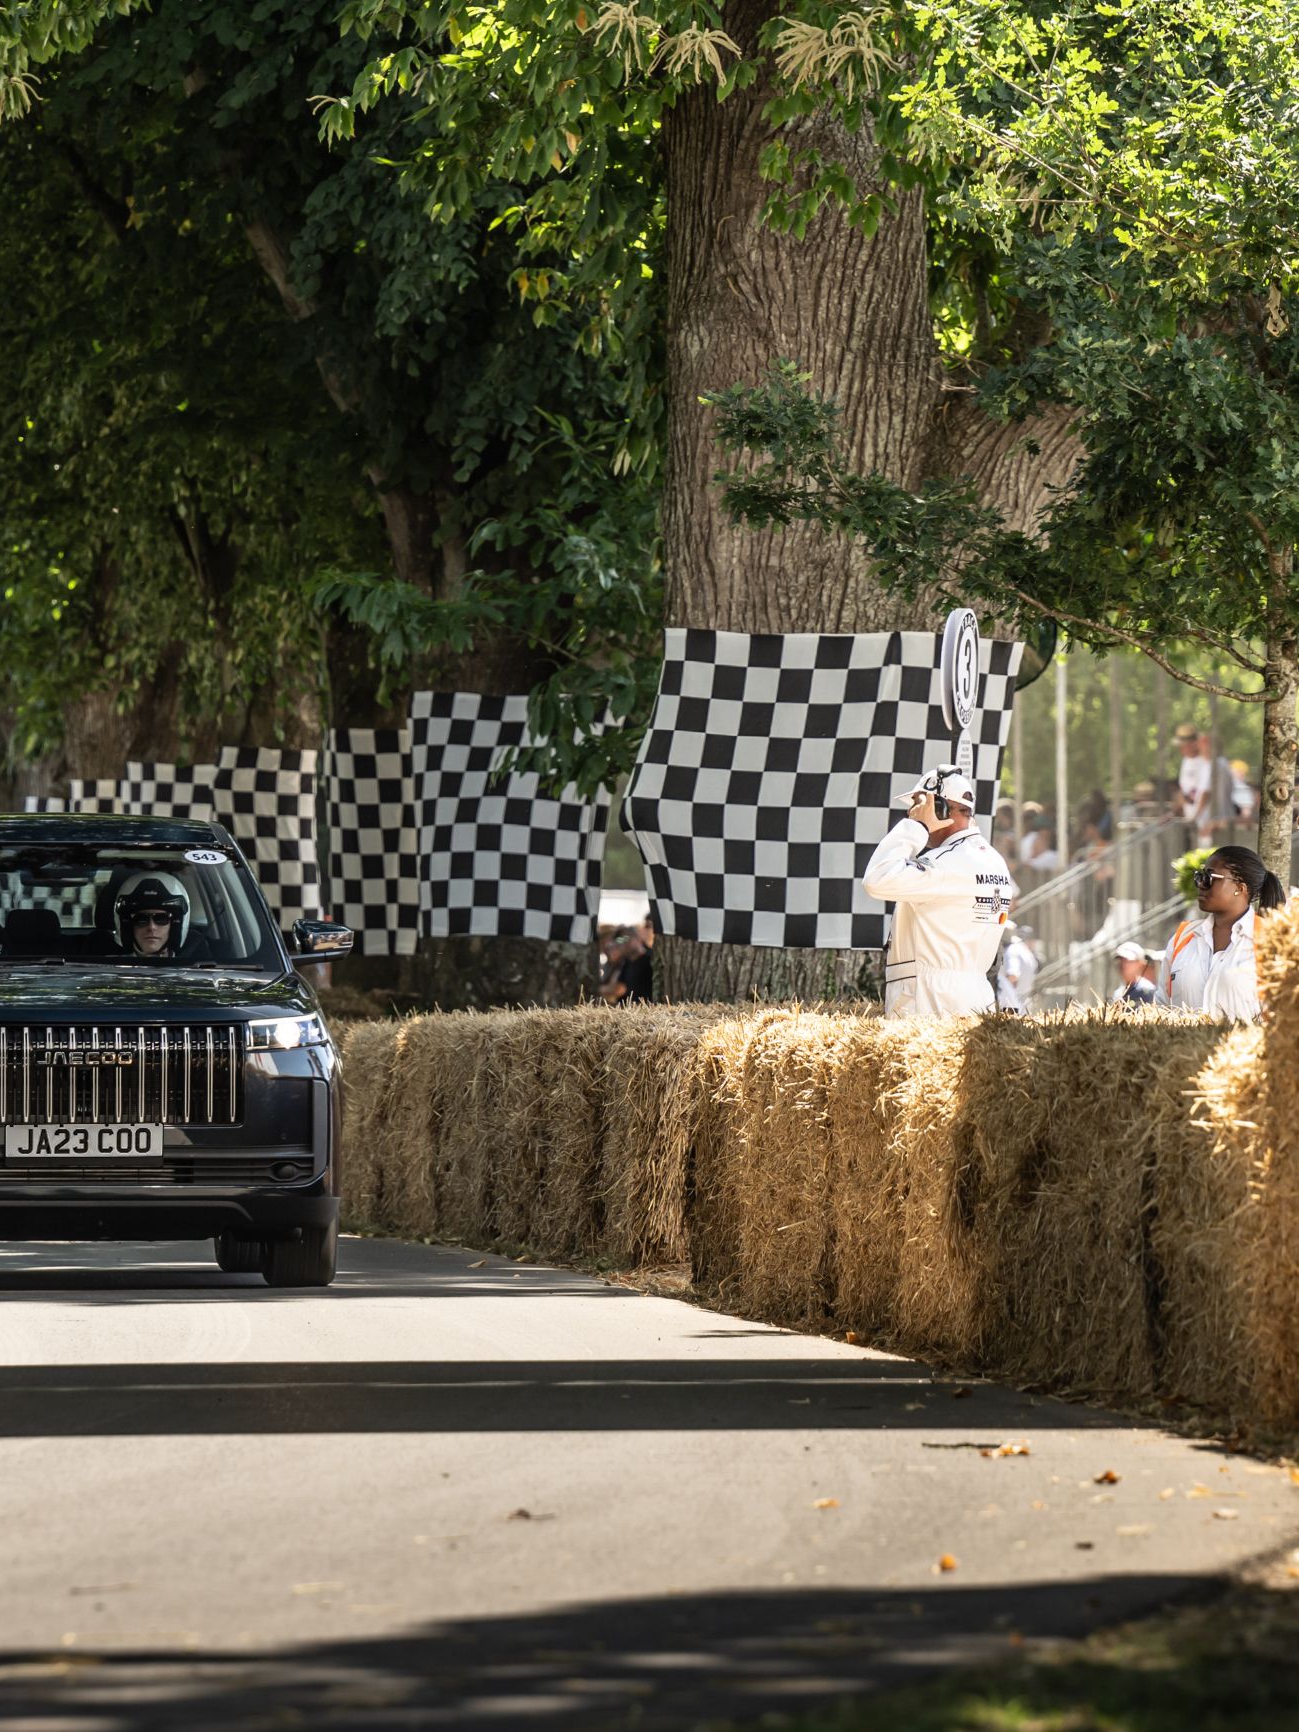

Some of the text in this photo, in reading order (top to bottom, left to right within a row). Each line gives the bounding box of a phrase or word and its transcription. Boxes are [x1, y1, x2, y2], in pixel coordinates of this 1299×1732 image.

[964, 638, 972, 699] 3
[191, 853, 217, 861] 543
[975, 874, 1010, 886] MARSHA
[36, 1051, 133, 1065] JAECOO
[17, 1127, 152, 1154] JA23 COO
